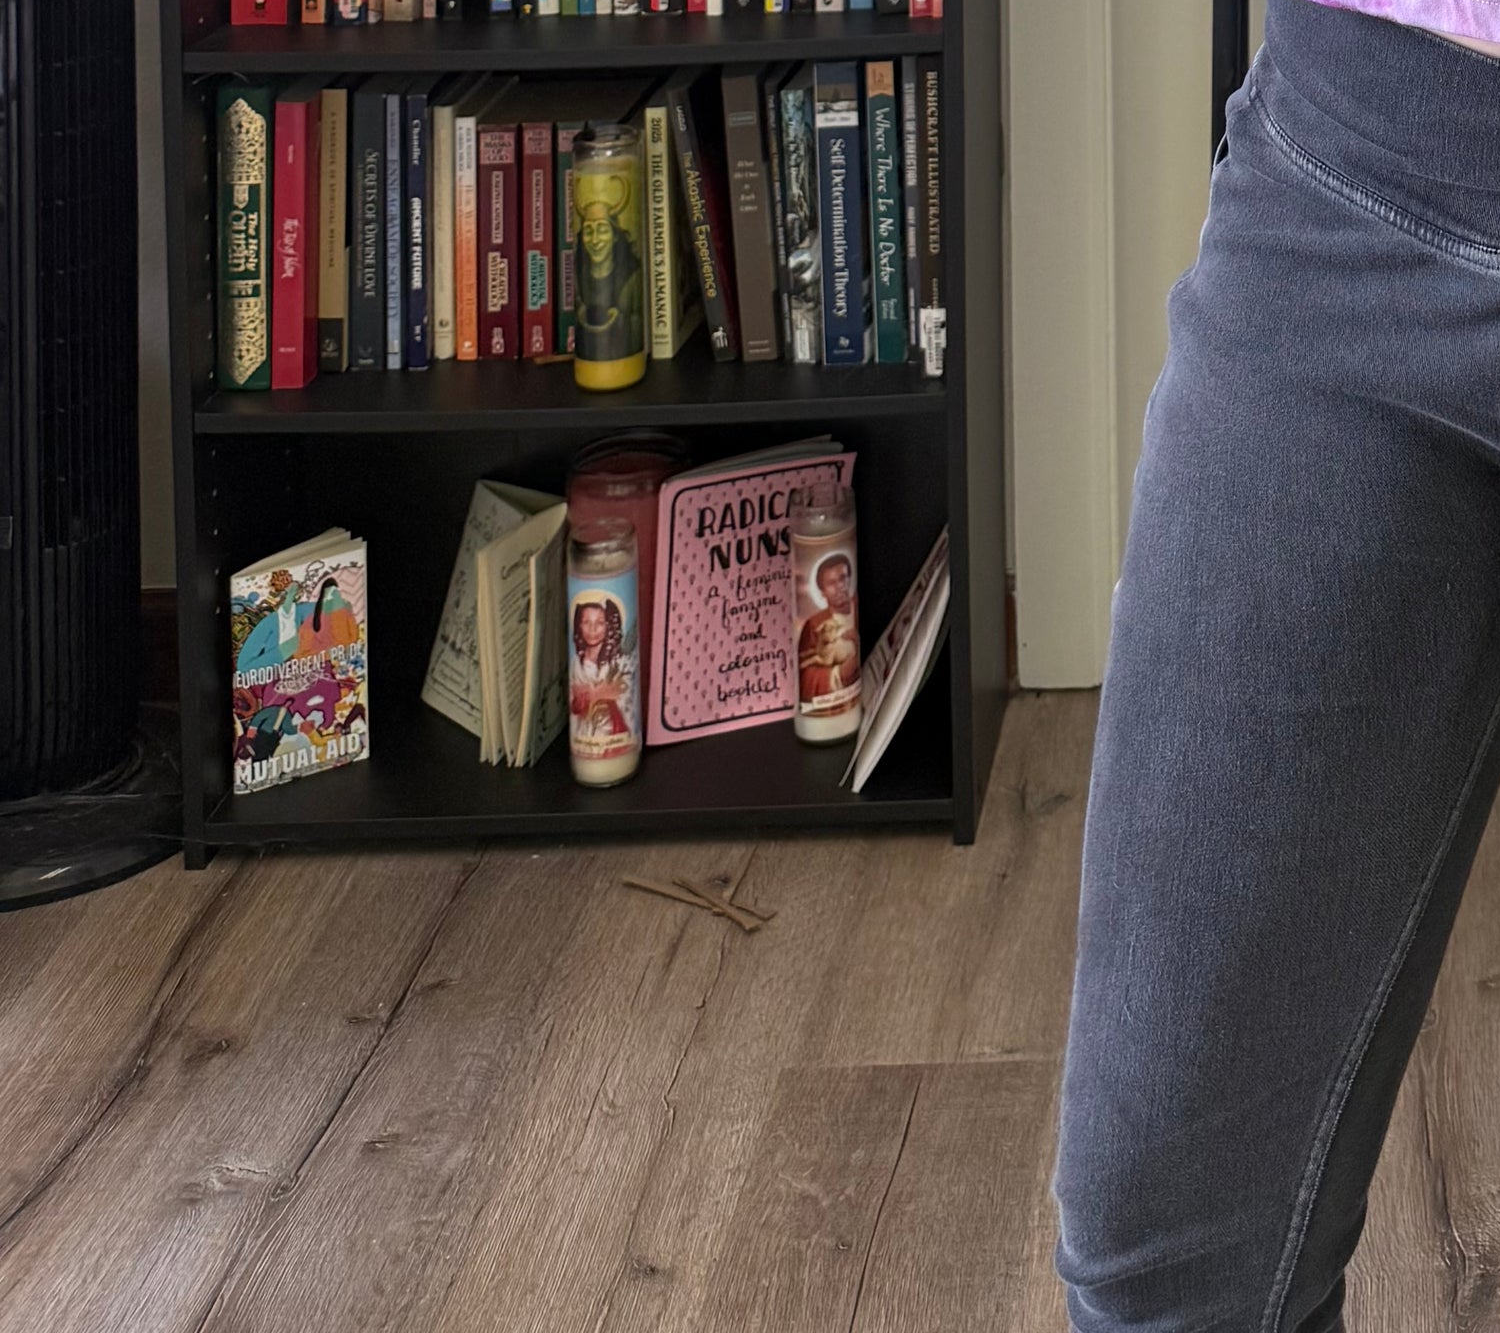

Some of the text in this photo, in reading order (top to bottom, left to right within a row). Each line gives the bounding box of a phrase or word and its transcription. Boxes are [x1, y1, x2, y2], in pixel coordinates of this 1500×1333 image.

[364, 149, 379, 202] SECRETS
[926, 71, 941, 254] BUSHCRAFT ILLUSTRATED
[365, 204, 378, 219] OF
[685, 170, 706, 222] Akashic
[875, 107, 897, 286] Where There Is No Doctor
[246, 211, 259, 272] The Holy
[651, 118, 667, 328] 2025 THE OLD FARMER'S ALMANAC
[830, 138, 851, 319] Self Determination Theory
[365, 268, 379, 298] LOVE
[695, 225, 719, 299] Experience
[709, 528, 792, 573] NUNS
[708, 583, 720, 600] a
[721, 594, 782, 630] fanzine
[718, 647, 788, 677] coloring
[736, 627, 766, 645] and
[235, 733, 362, 786] MUTUAL AID
